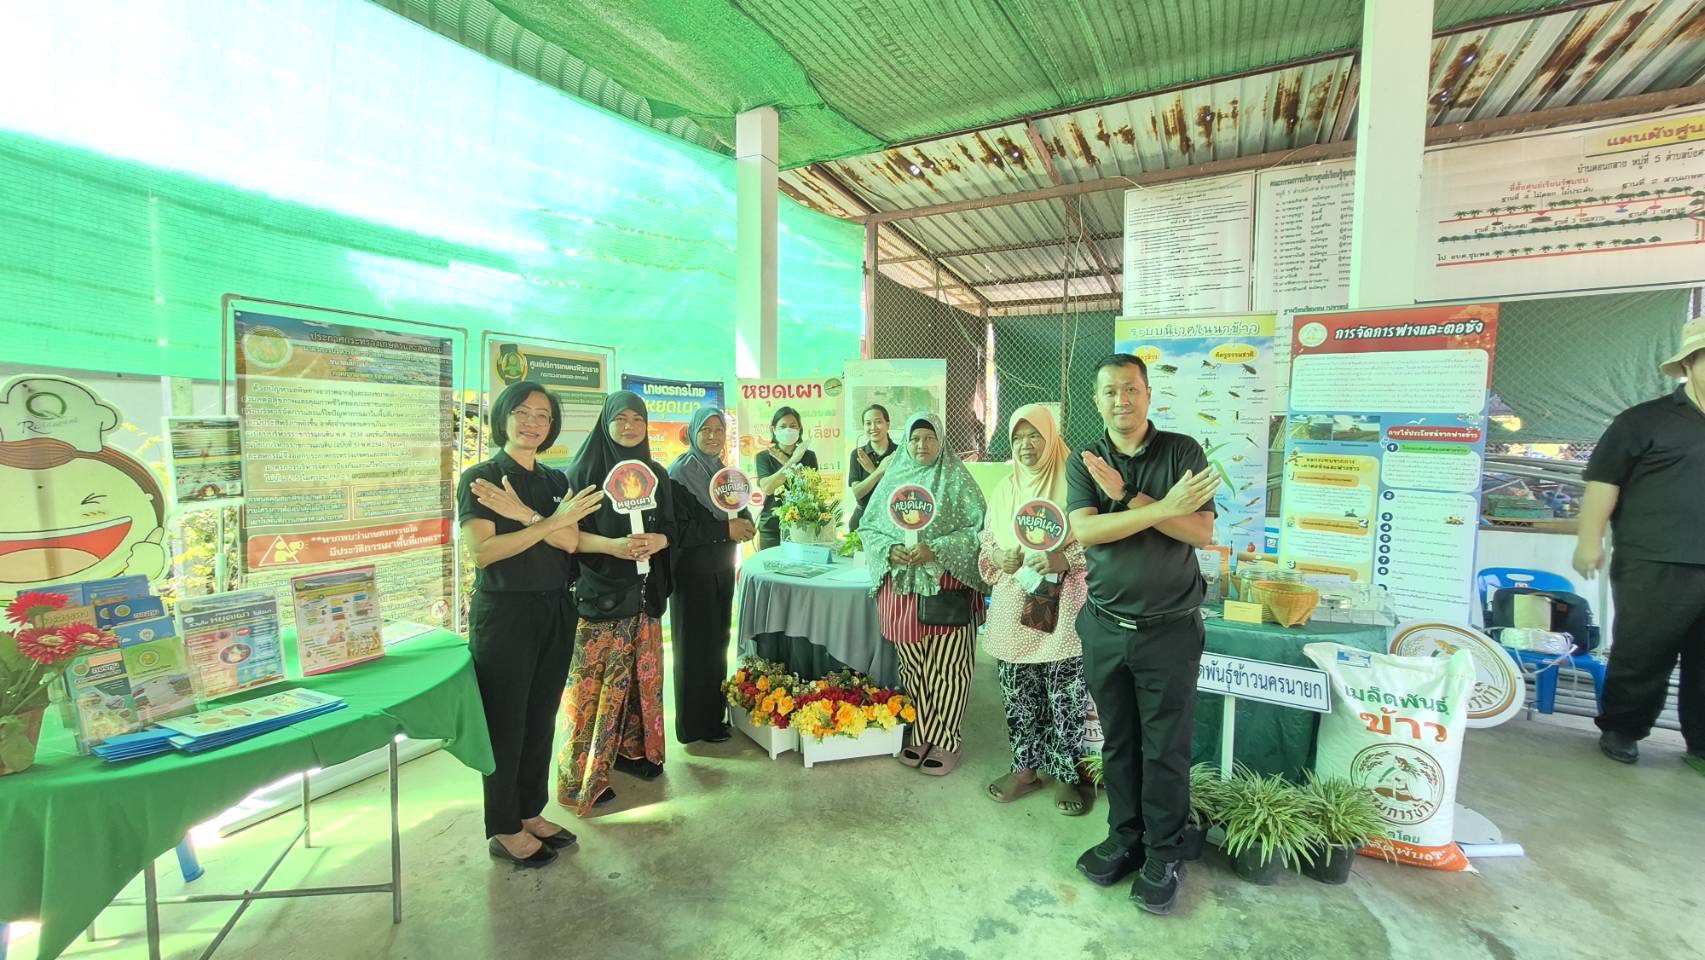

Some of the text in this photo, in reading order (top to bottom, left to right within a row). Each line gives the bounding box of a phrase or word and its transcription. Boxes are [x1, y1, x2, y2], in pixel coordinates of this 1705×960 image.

[1655, 153, 1660, 163] 5
[1130, 322, 1260, 337] ระบบนิเวศในนาข้าว
[1335, 319, 1483, 340] การจัดการฟางและตอซัง
[643, 383, 705, 397] เกษตรกรไทย
[741, 383, 822, 408] หยุดเผา
[714, 483, 750, 497] หยุดเผา
[617, 497, 651, 510] หยุดเผา
[892, 499, 933, 515] หยุดเผา
[1016, 514, 1063, 538] หยุดเผา
[1345, 685, 1450, 715] เมล็ดพันธุ์
[1359, 706, 1448, 742] ข้าว
